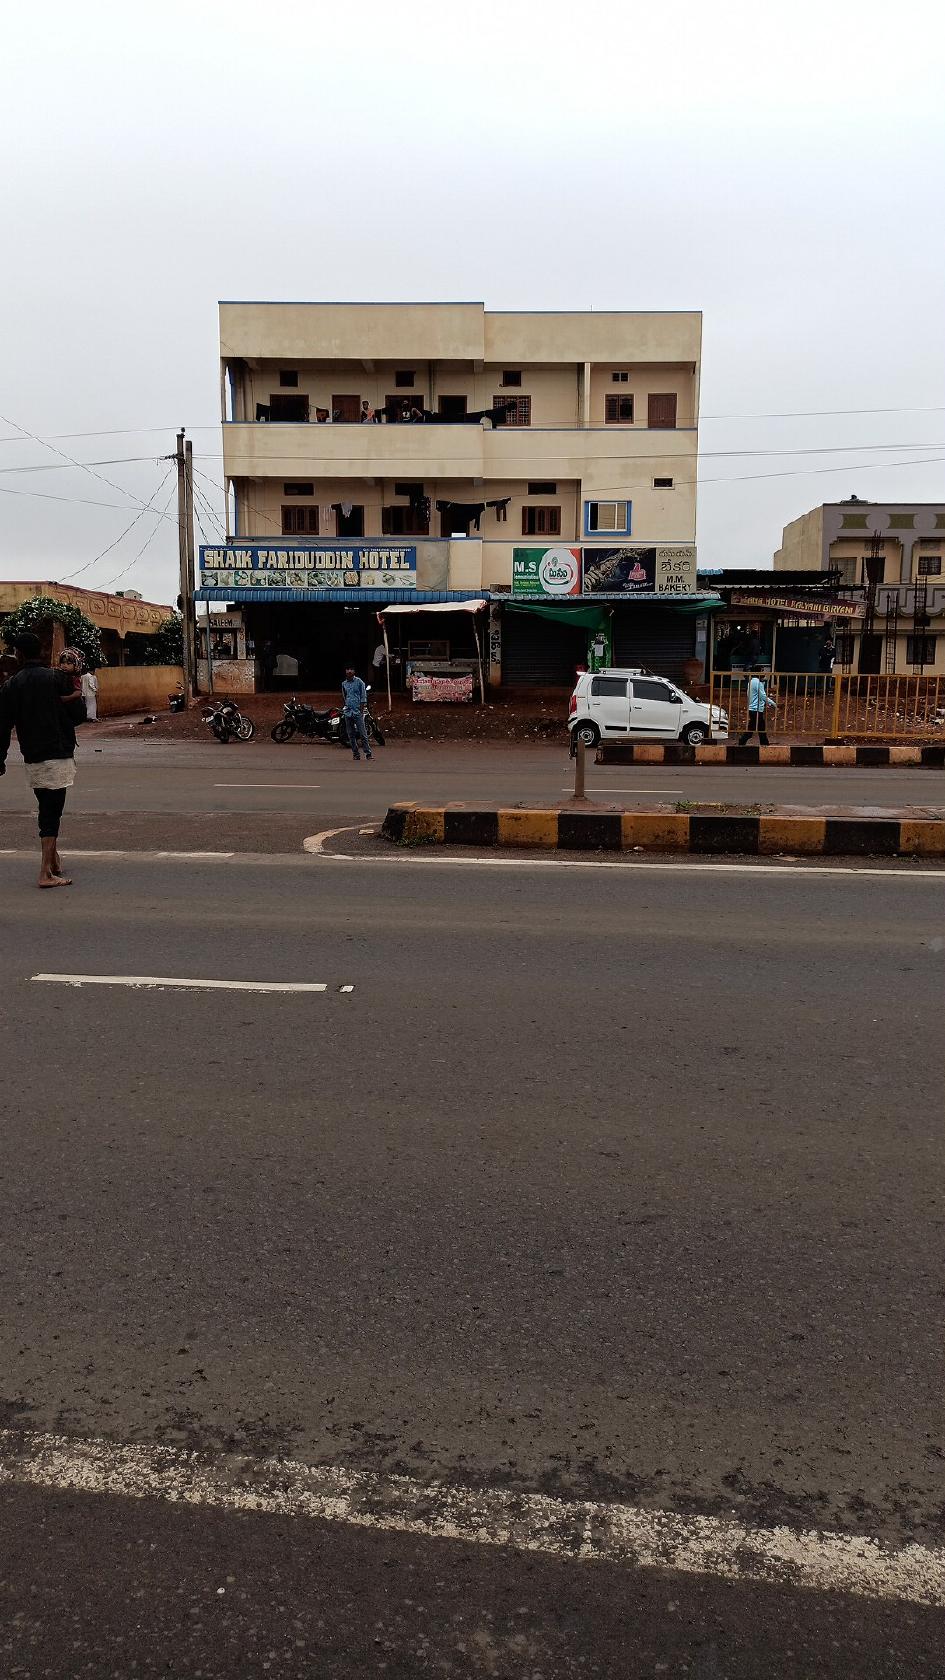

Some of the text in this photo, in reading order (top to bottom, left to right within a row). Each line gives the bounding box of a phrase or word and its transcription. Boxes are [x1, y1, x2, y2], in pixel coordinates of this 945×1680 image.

[204, 550, 410, 569] SHAIK FARIDUDDIN HOTEL
[514, 561, 537, 573] M.S
[658, 584, 692, 592] BAKERY
